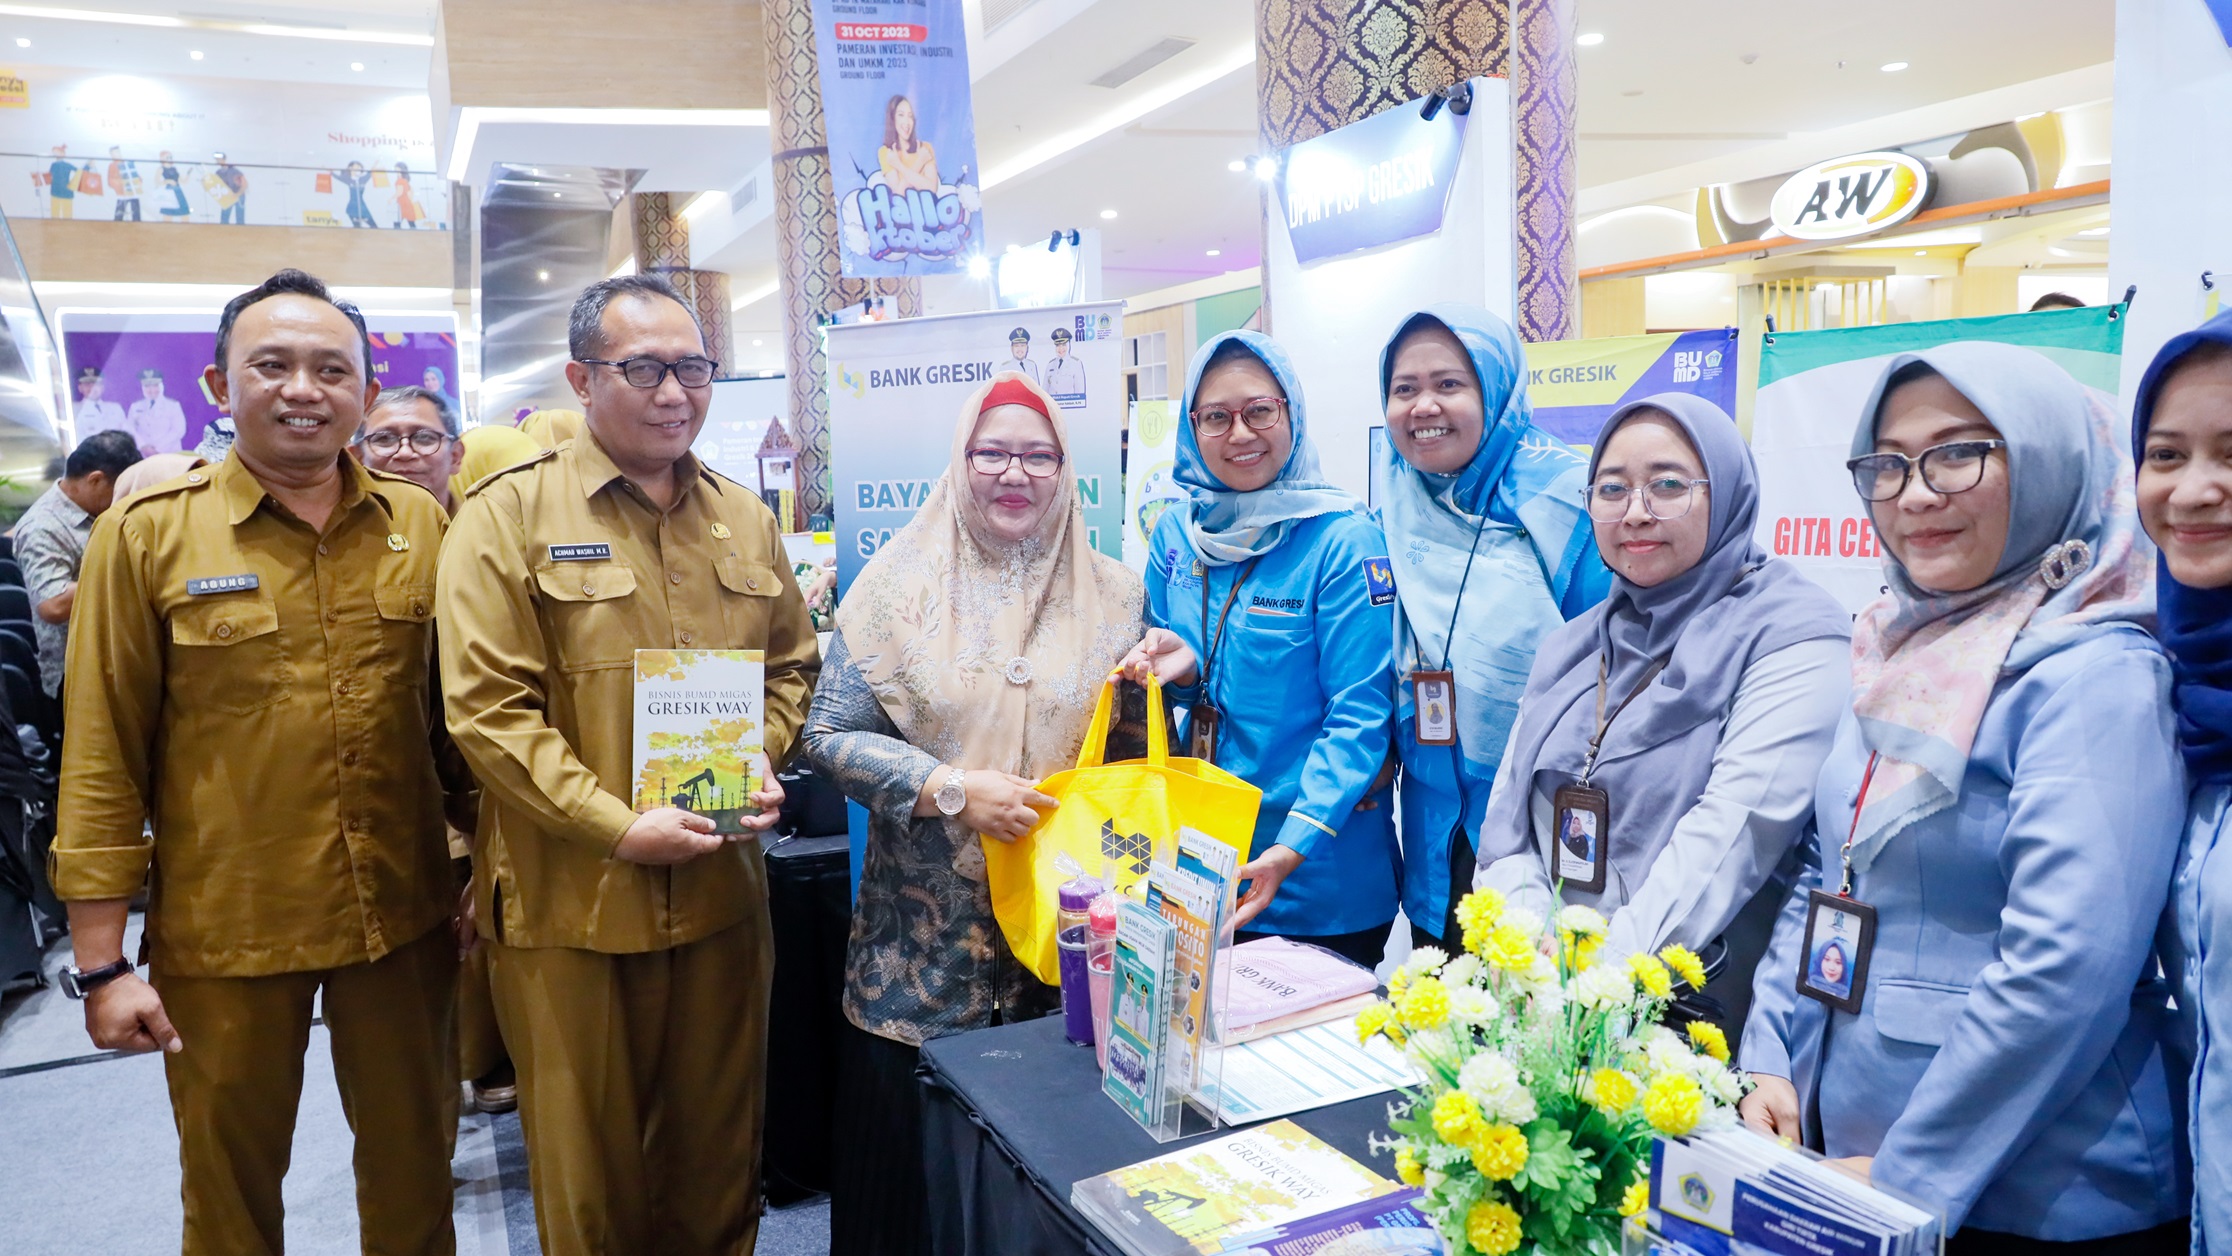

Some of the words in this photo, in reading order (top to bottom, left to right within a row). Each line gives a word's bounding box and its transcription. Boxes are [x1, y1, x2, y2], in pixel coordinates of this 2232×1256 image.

[832, 6, 857, 14] GROUND
[859, 6, 878, 15] FLOOR
[841, 26, 854, 37] 31
[855, 27, 880, 38] OCT
[882, 27, 910, 38] 2023
[837, 44, 876, 54] PAMERAN
[920, 47, 953, 58] INDUSTRI
[838, 58, 855, 68] DAN
[859, 58, 884, 68] UMKM
[887, 58, 908, 68] 2023
[840, 71, 864, 79] GROUND
[866, 71, 886, 80] FLOOR
[1369, 149, 1435, 204] GRESIK
[870, 367, 922, 389] BANK
[926, 362, 993, 384] GRESIK
[1549, 365, 1617, 384] GRESIK
[1773, 516, 1832, 557] GITA
[200, 577, 246, 590] AGUNG
[1252, 595, 1280, 608] BANK
[648, 690, 681, 699] BISNIS
[685, 690, 716, 699] BUMD
[719, 690, 752, 699] MIGAS
[647, 702, 711, 715] GRESIK
[716, 701, 752, 715] WAY
[1162, 908, 1207, 941] TABUNGAN
[1228, 1142, 1284, 1179] GRESIK
[1280, 1176, 1320, 1200] WAY
